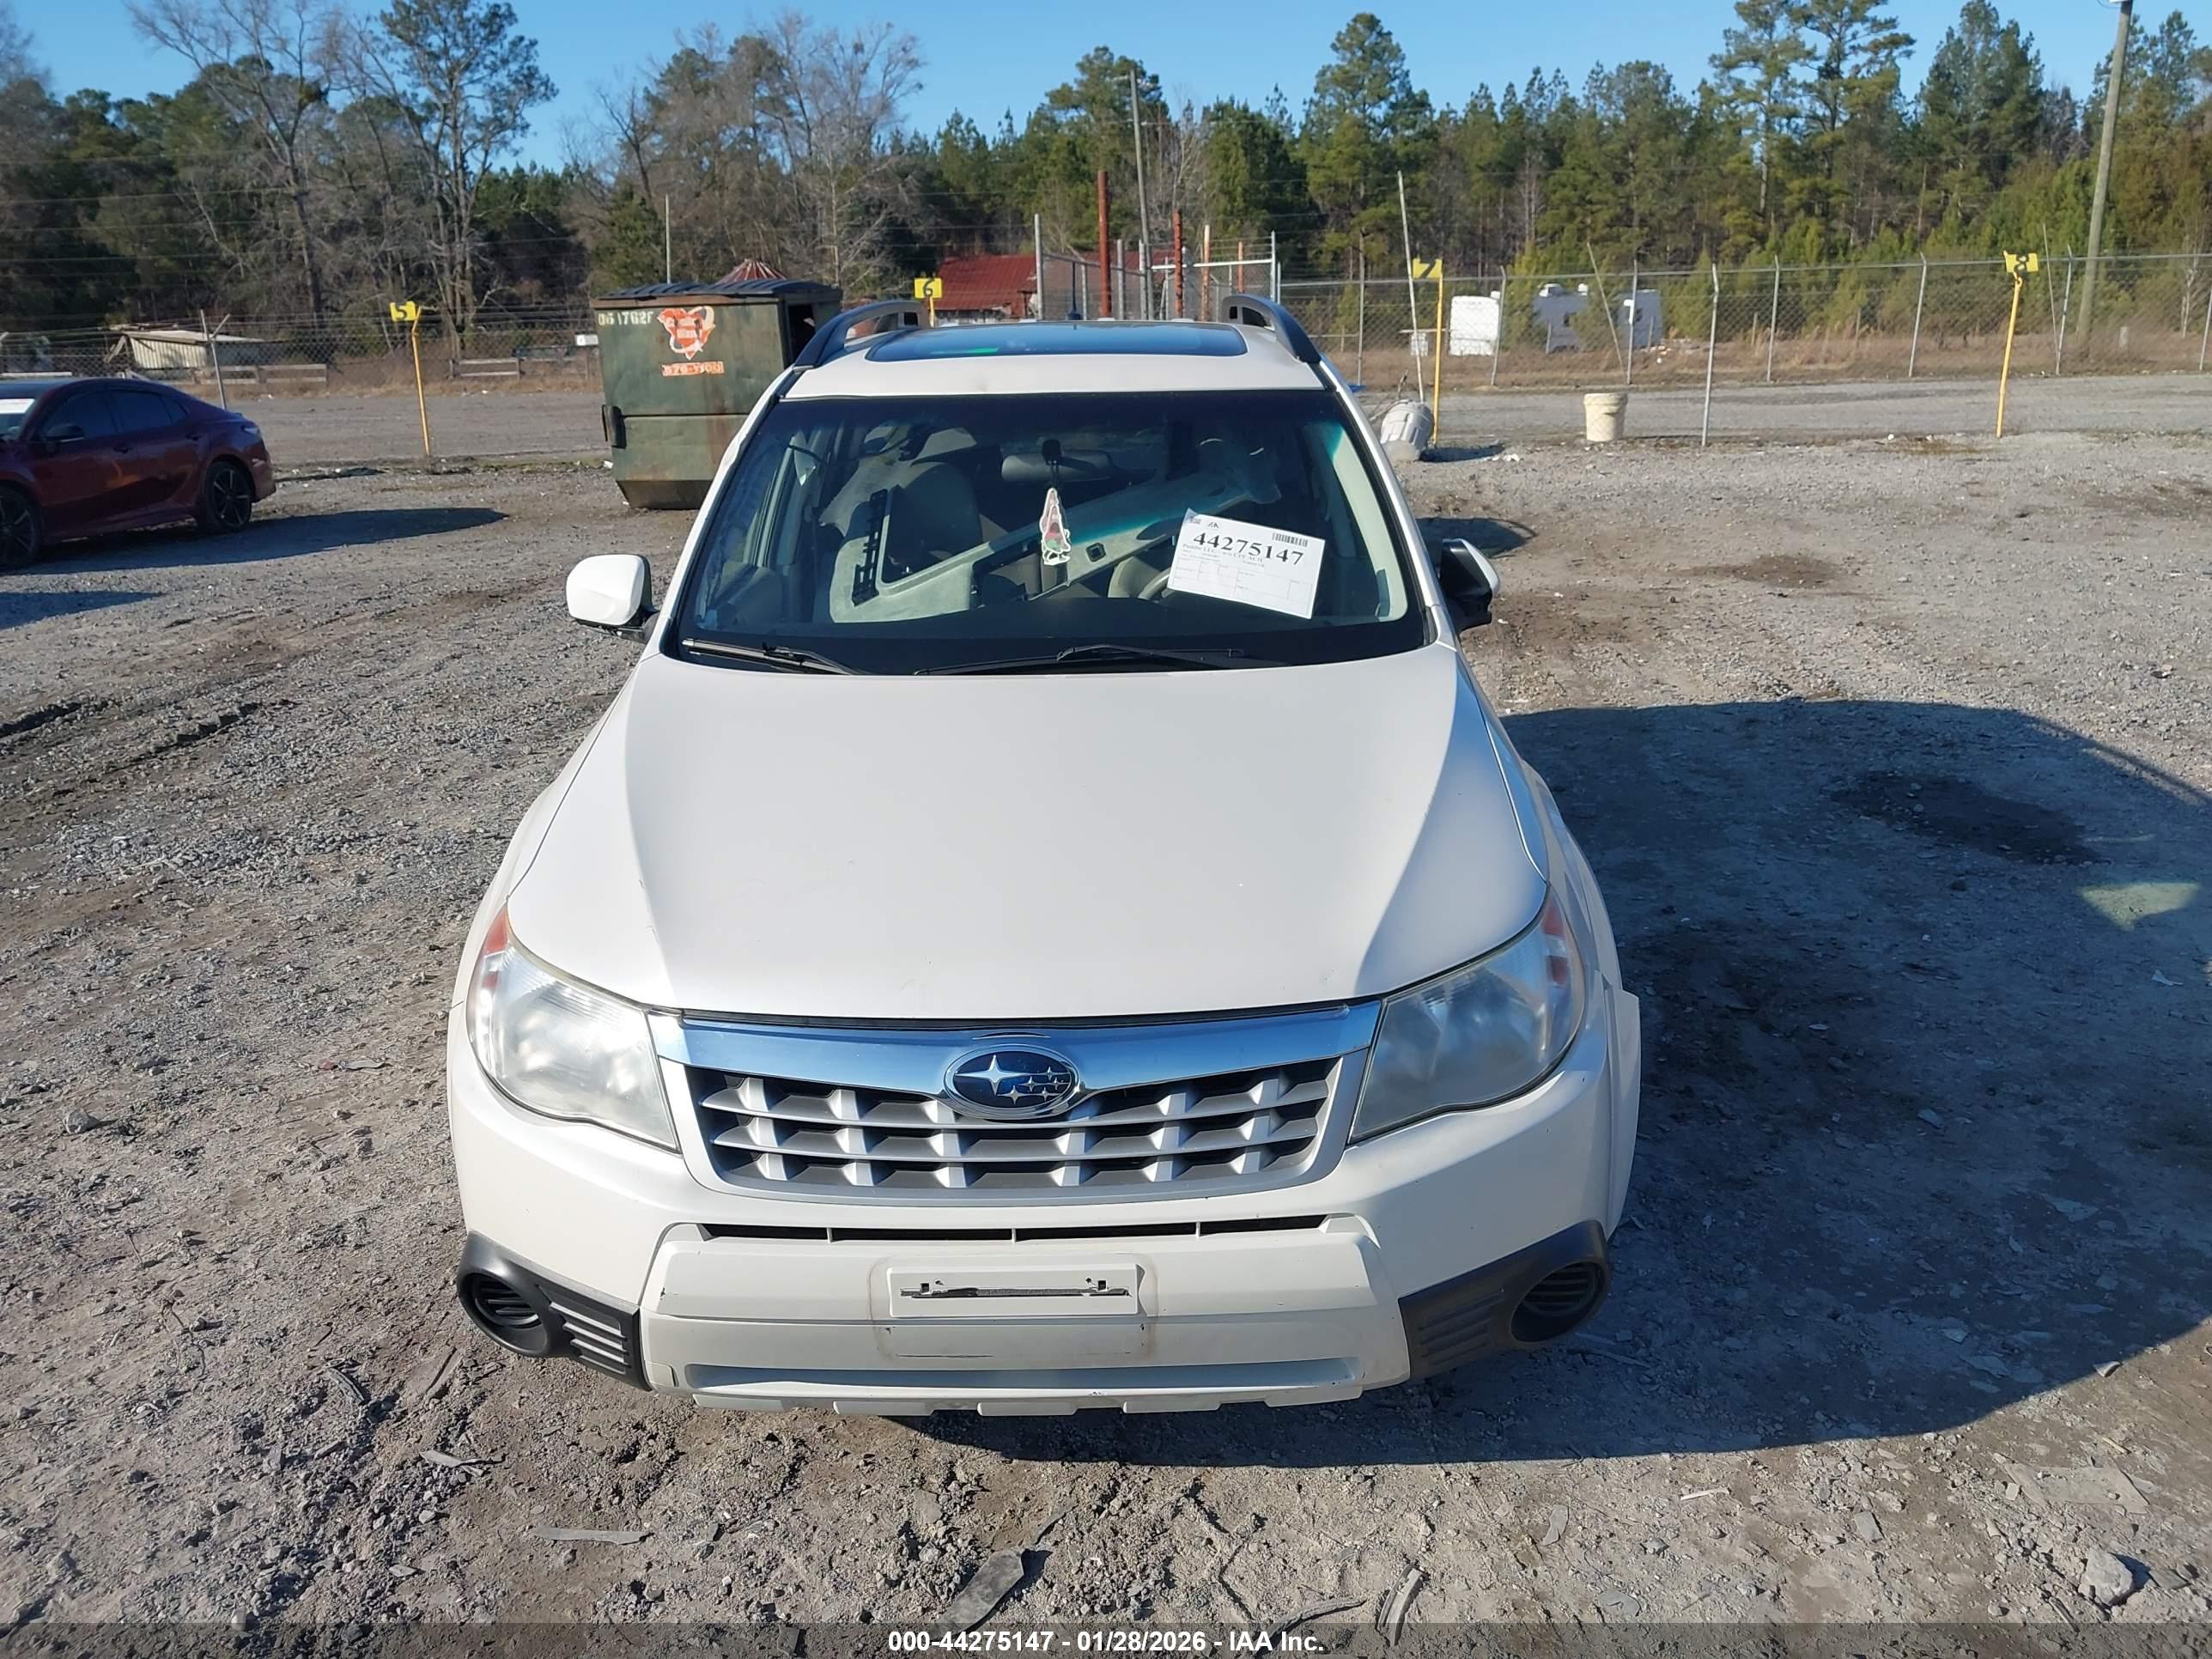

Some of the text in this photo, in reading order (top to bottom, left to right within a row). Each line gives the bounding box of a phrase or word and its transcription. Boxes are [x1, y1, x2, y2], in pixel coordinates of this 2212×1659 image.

[1419, 258, 1437, 279] 7
[922, 277, 935, 297] 6
[395, 301, 407, 320] 5
[1193, 532, 1304, 566] 44275147
